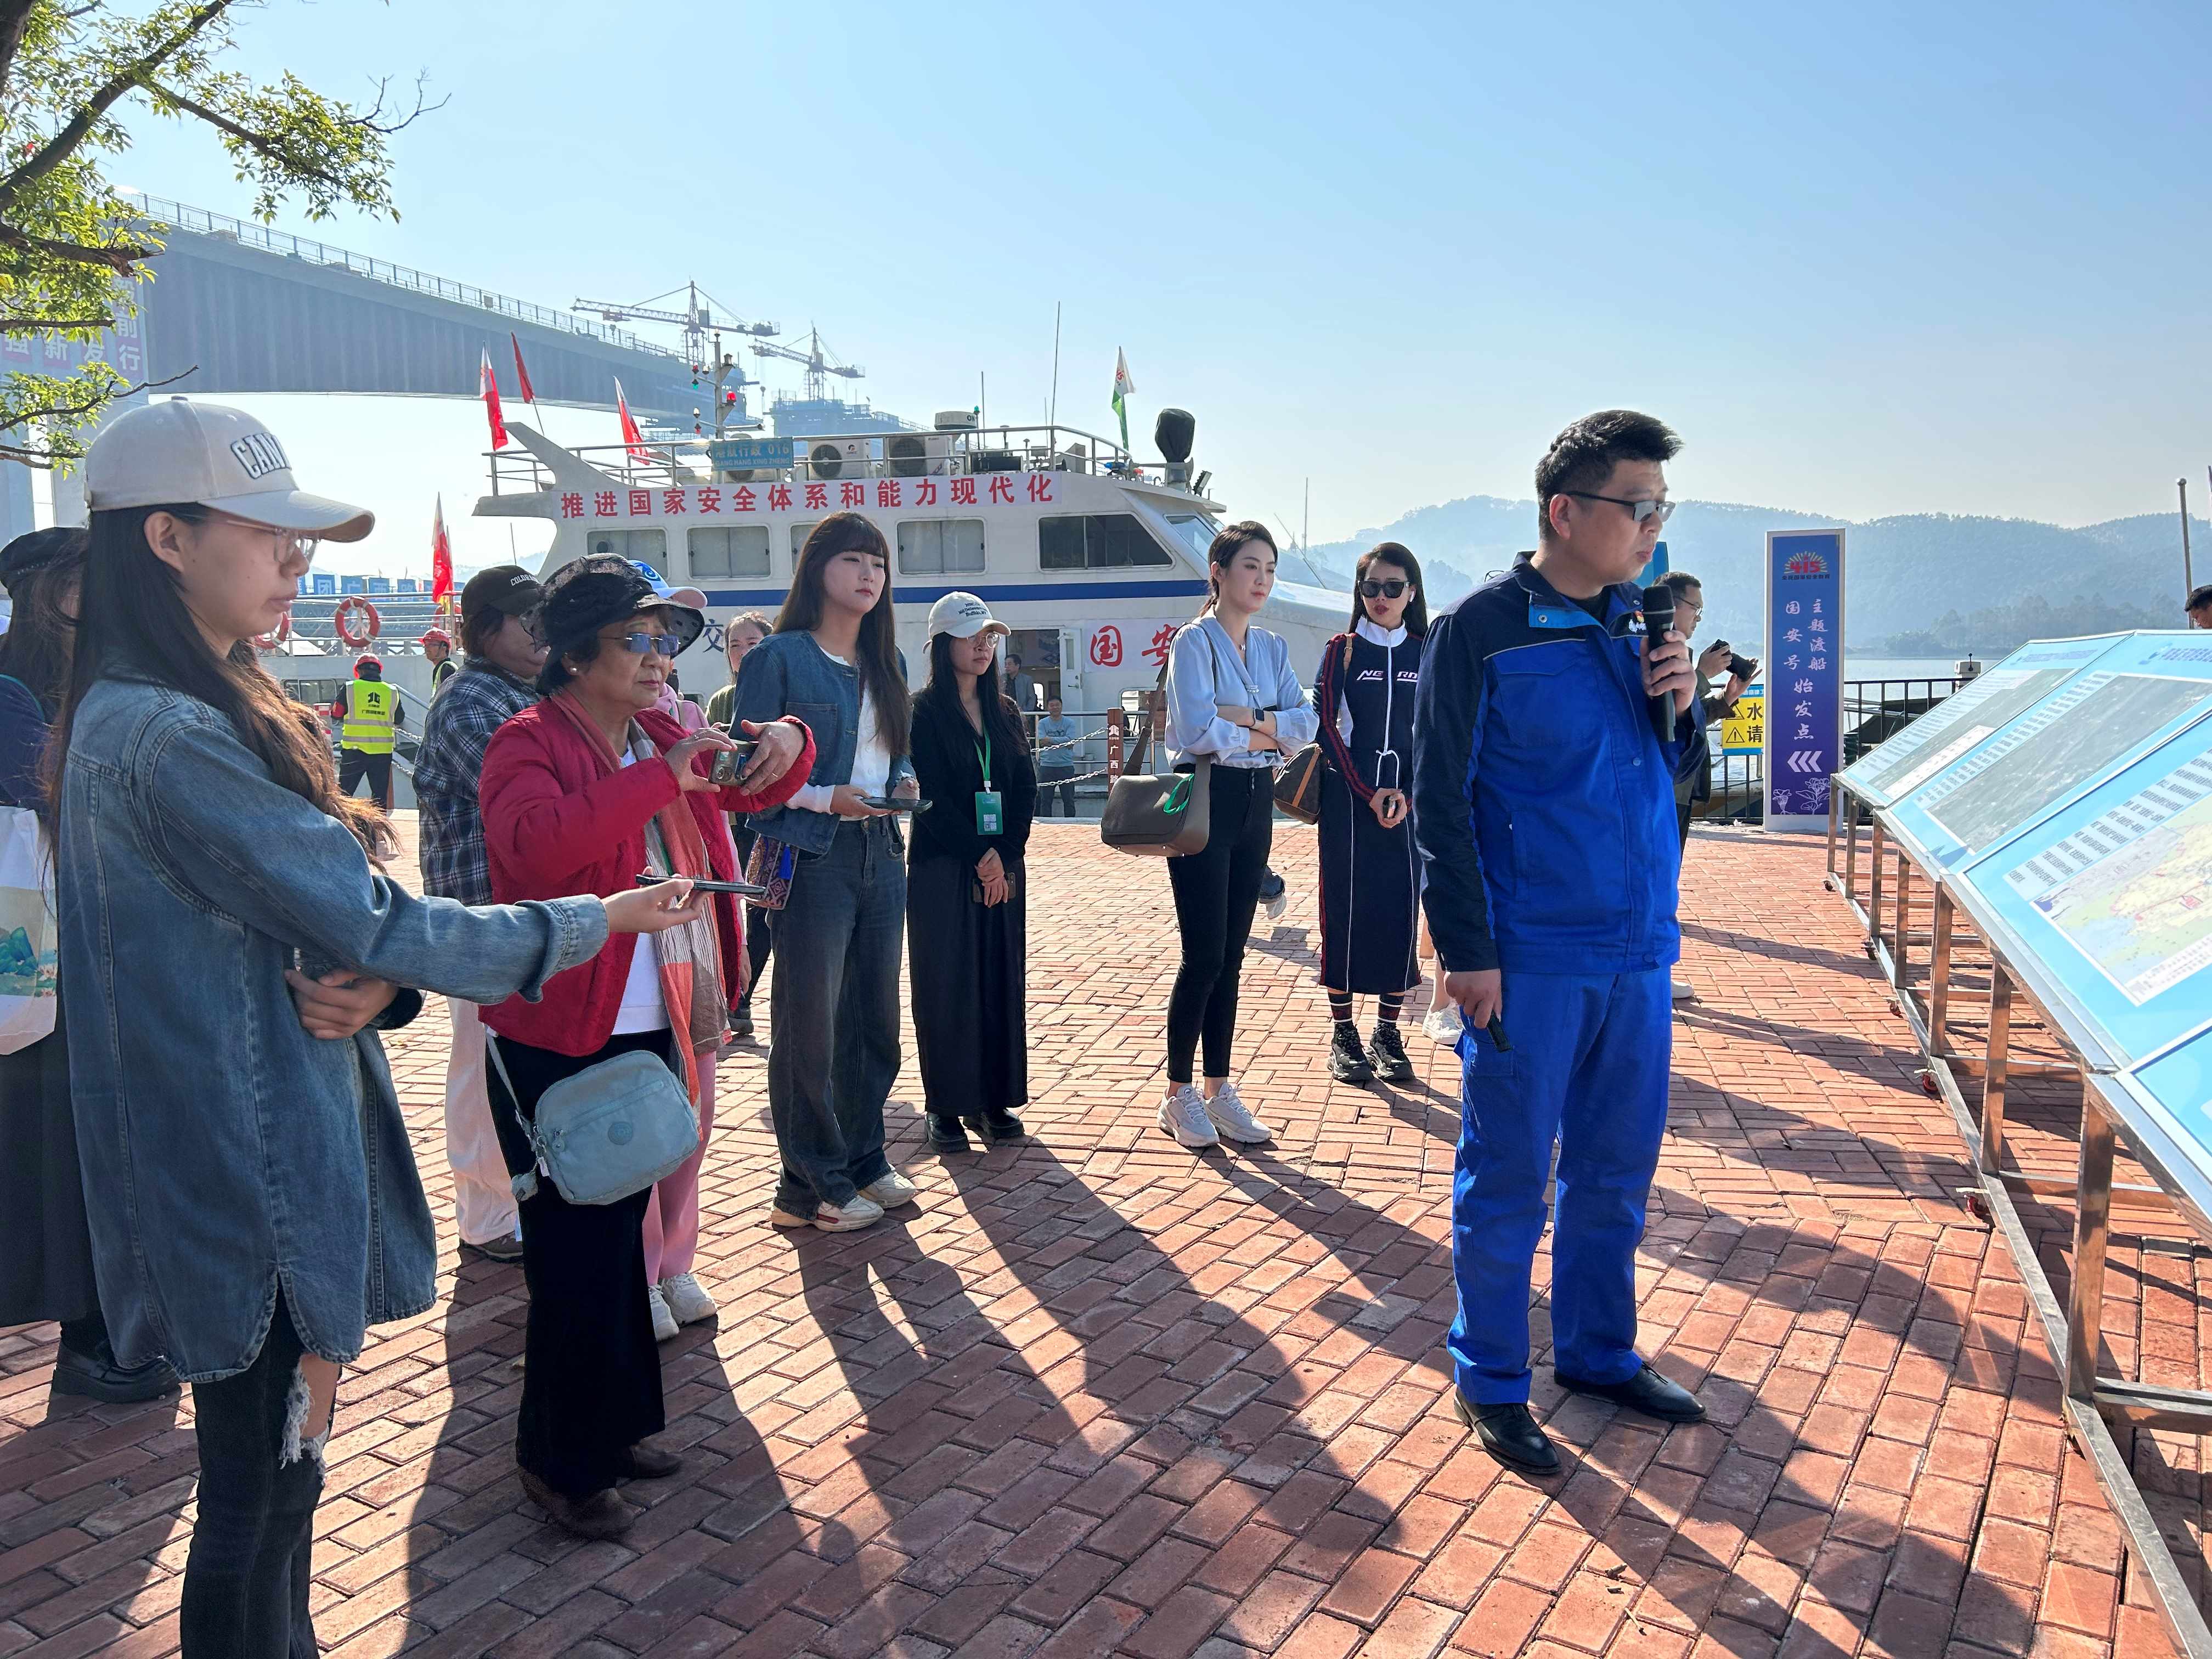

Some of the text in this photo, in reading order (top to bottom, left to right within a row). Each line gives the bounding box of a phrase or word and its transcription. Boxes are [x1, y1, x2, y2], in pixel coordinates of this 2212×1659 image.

[44, 335, 69, 361] 新
[768, 444, 789, 455] 016
[561, 474, 1053, 518] 推进国家安全体系和能力现代化
[703, 619, 724, 653] 交
[1783, 601, 1803, 670] 国安号
[1808, 599, 1829, 671] 主题渡船
[1747, 702, 1763, 720] 水
[1793, 678, 1814, 741] 始发点
[1747, 725, 1763, 743] 请
